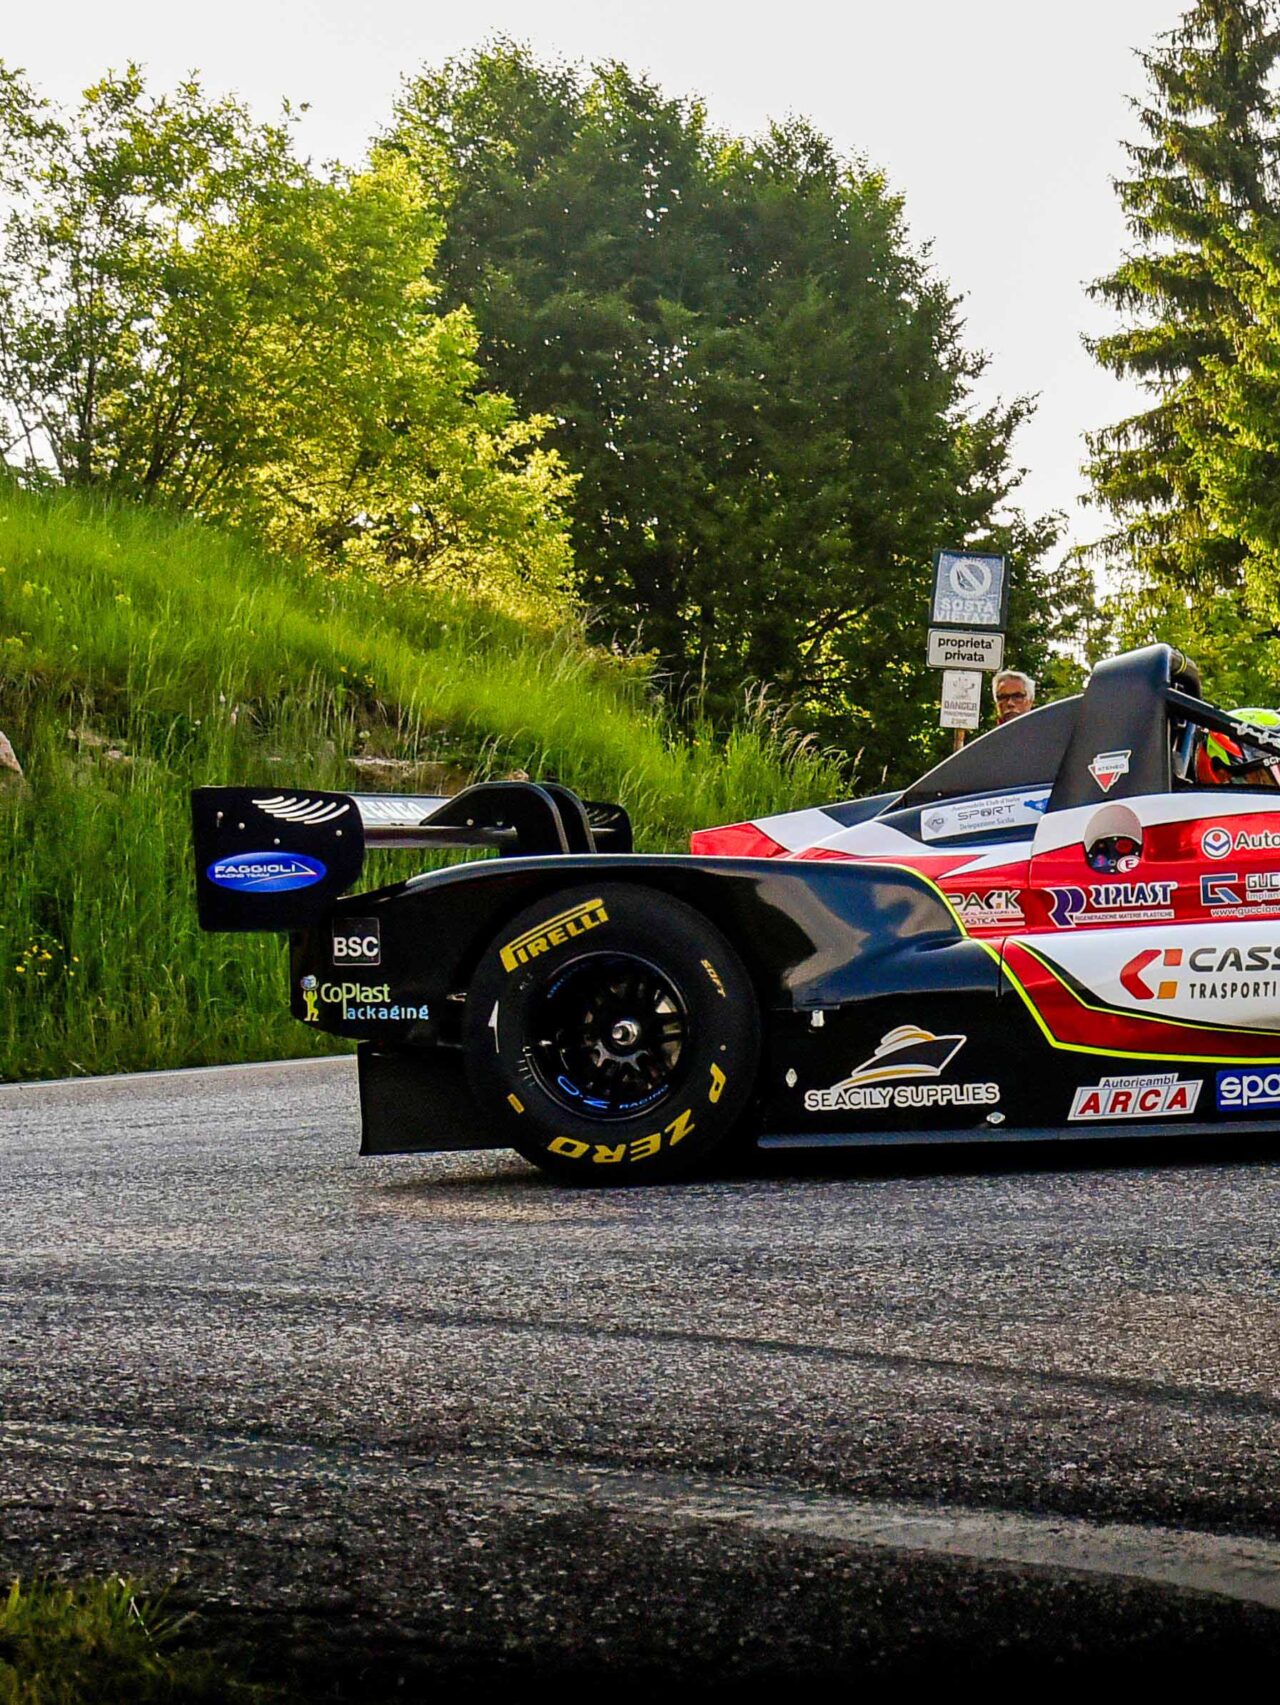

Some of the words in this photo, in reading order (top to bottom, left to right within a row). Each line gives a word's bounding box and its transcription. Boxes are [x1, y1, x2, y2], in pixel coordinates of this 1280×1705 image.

[940, 598, 994, 613] SOSTA
[945, 650, 985, 662] privata
[958, 804, 1016, 820] SPORT
[215, 864, 296, 873] FAGGIOLI
[1091, 883, 1173, 906] RIPLAST
[333, 936, 379, 957] BSC
[500, 898, 609, 973] PIRELLI
[700, 959, 726, 998] SOFT
[1190, 980, 1277, 999] TRASPORTI
[708, 1062, 727, 1103] P
[1102, 1074, 1176, 1089] Autoricambi
[805, 1088, 889, 1109] SEACILY
[894, 1084, 999, 1105] SUPPLIES
[1078, 1087, 1189, 1115] ARCA
[546, 1108, 696, 1163] ZERO
